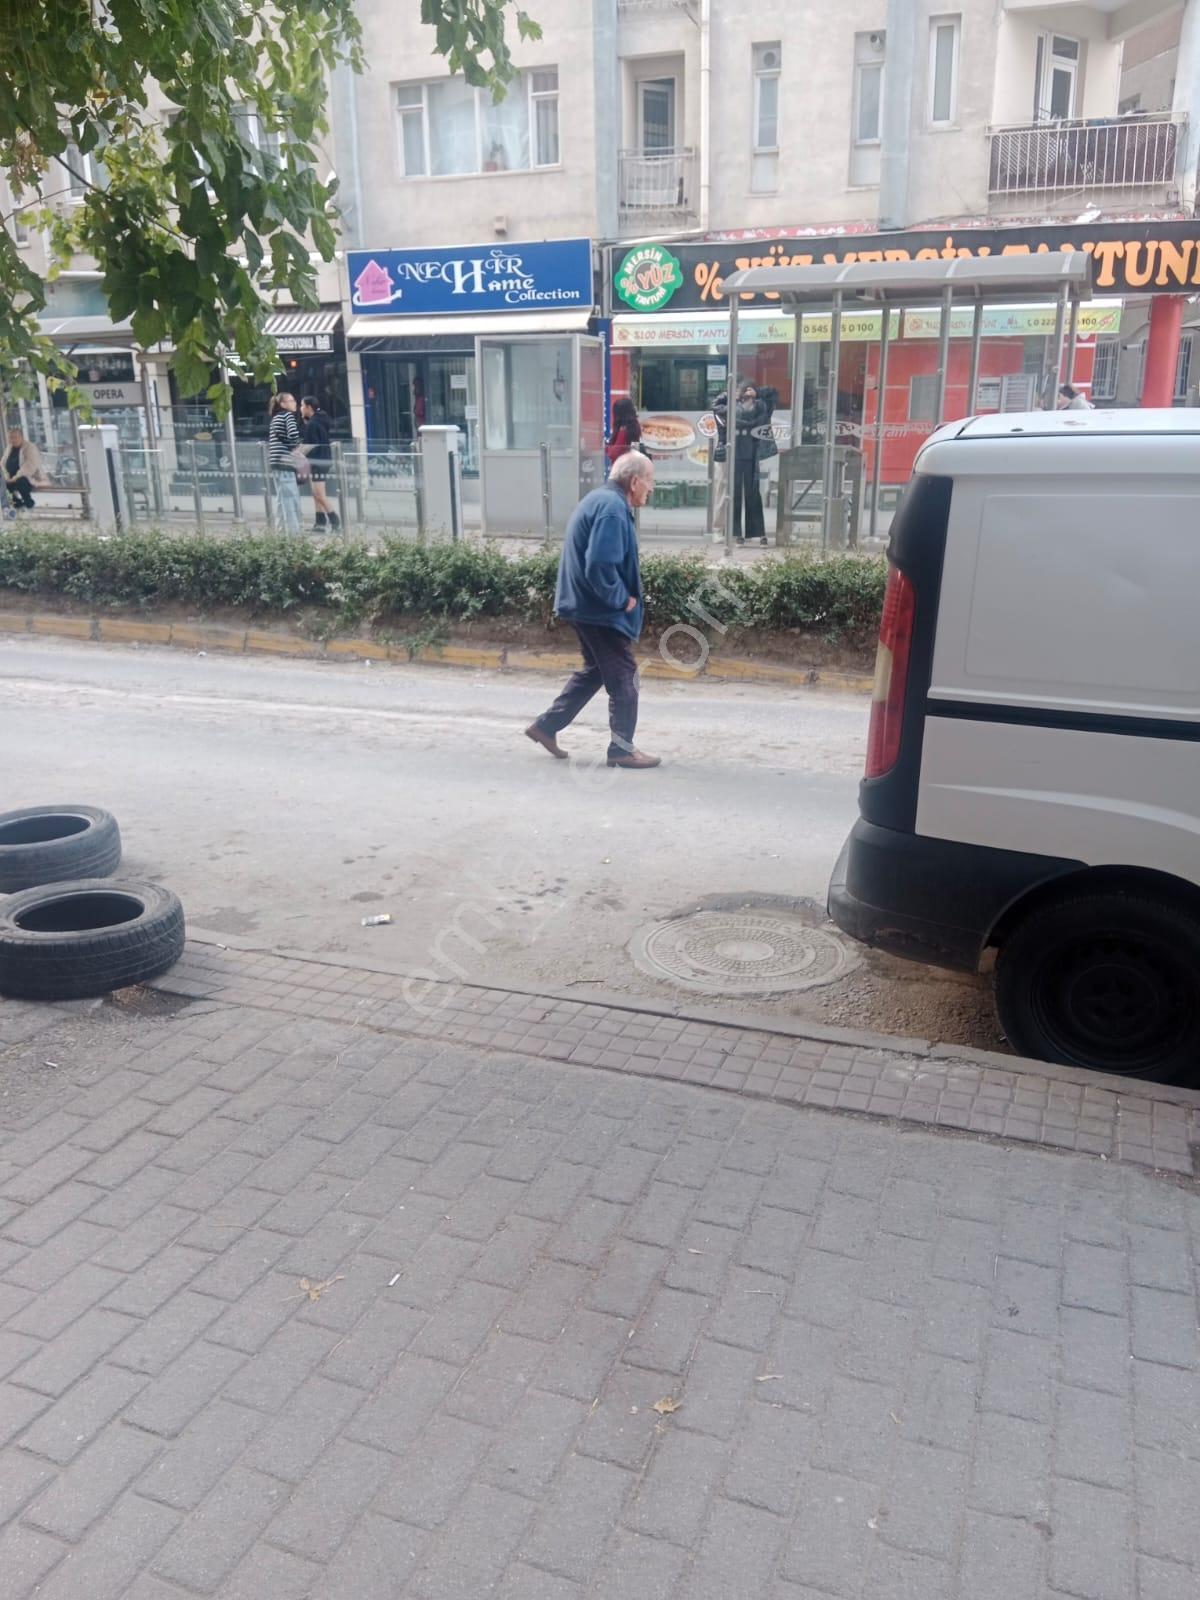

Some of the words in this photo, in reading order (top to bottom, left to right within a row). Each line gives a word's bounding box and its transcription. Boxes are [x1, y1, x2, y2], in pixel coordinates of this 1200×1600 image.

[623, 247, 663, 275] MERSİN
[694, 261, 724, 301] %
[504, 288, 580, 304] Collection
[1082, 317, 1097, 326] 100
[811, 325, 829, 334] 545
[857, 323, 874, 332] 100
[93, 389, 125, 400] OPERA
